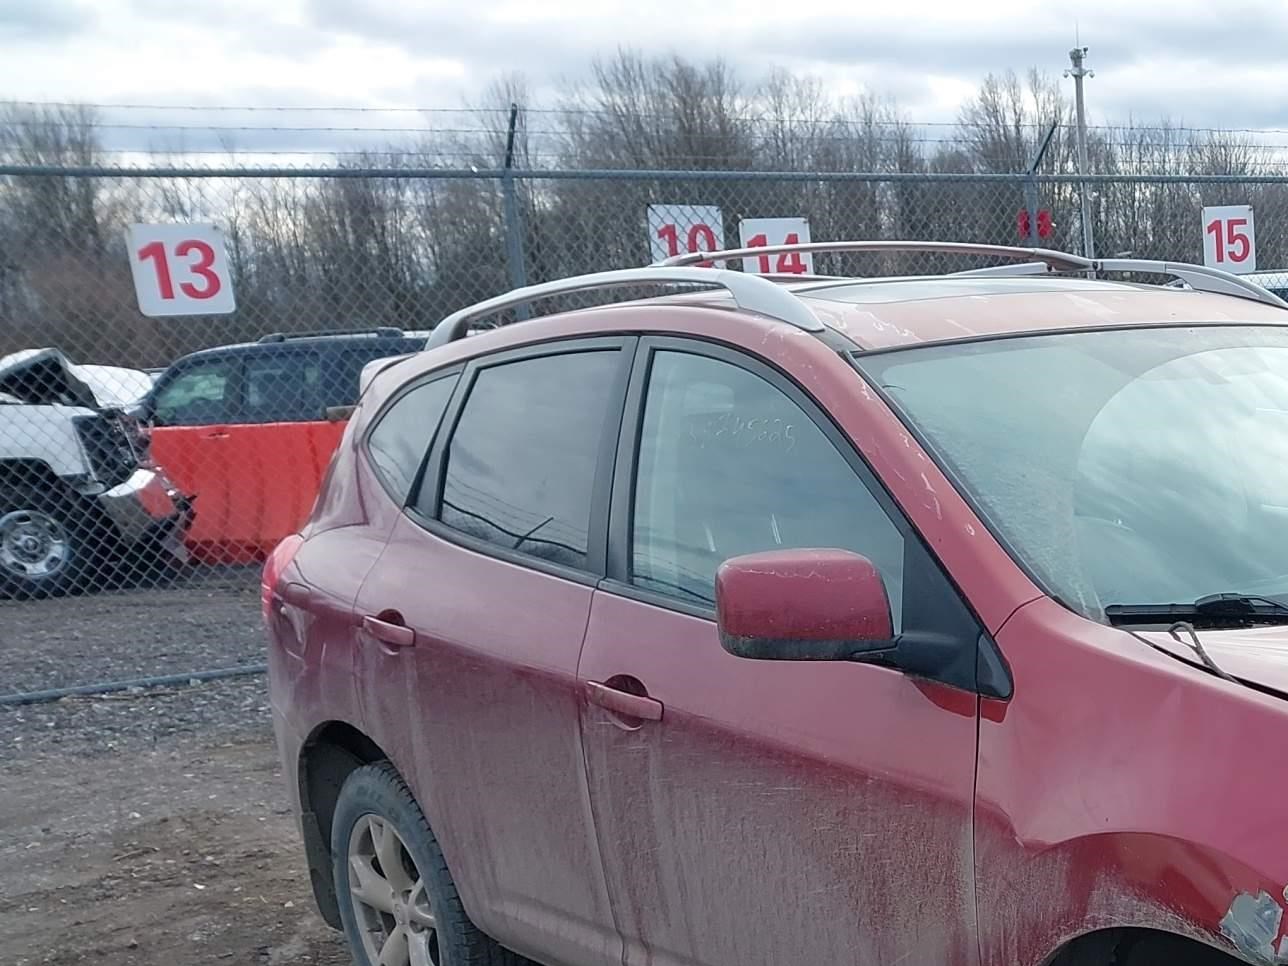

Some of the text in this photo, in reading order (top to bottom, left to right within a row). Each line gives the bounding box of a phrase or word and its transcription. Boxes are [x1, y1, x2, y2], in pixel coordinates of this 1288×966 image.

[746, 233, 807, 274] 14
[1207, 218, 1250, 263] 15
[137, 239, 221, 300] 13
